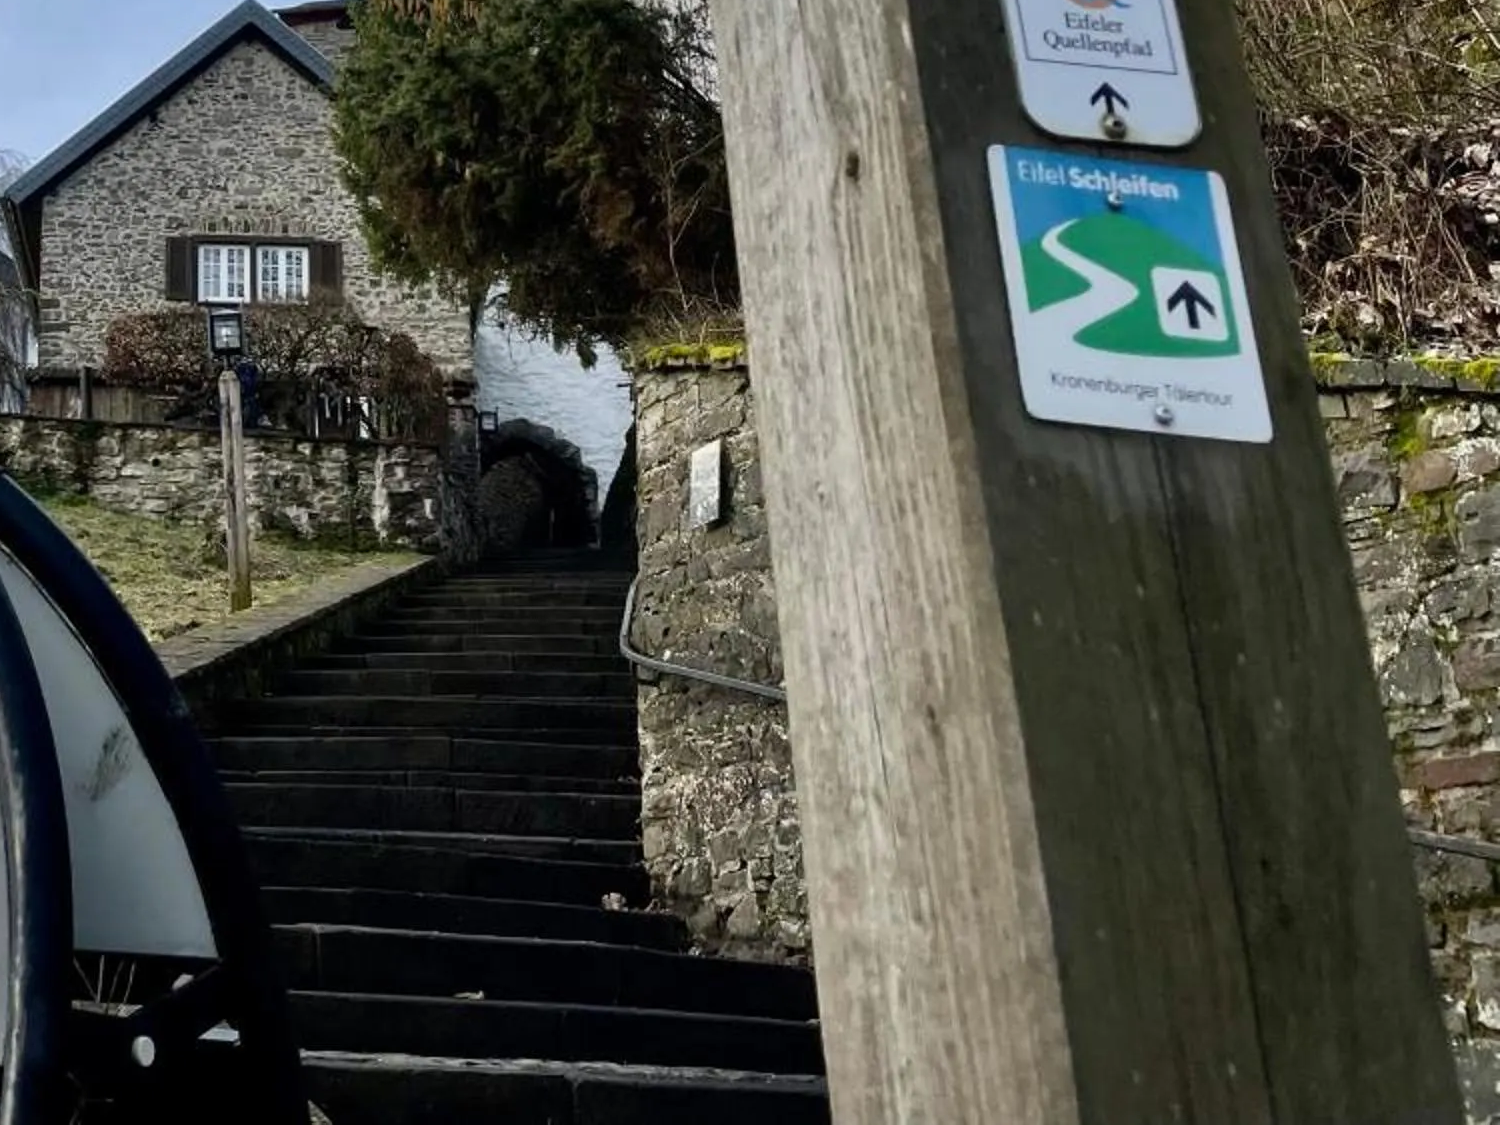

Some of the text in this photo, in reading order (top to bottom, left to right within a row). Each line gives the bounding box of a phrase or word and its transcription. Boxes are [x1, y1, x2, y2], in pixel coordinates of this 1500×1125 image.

[1063, 11, 1125, 34] Eifeler
[1042, 29, 1154, 59] Quellenpfad
[1017, 159, 1180, 202] Eifel Schleifen
[1050, 372, 1160, 401] Kronenburger
